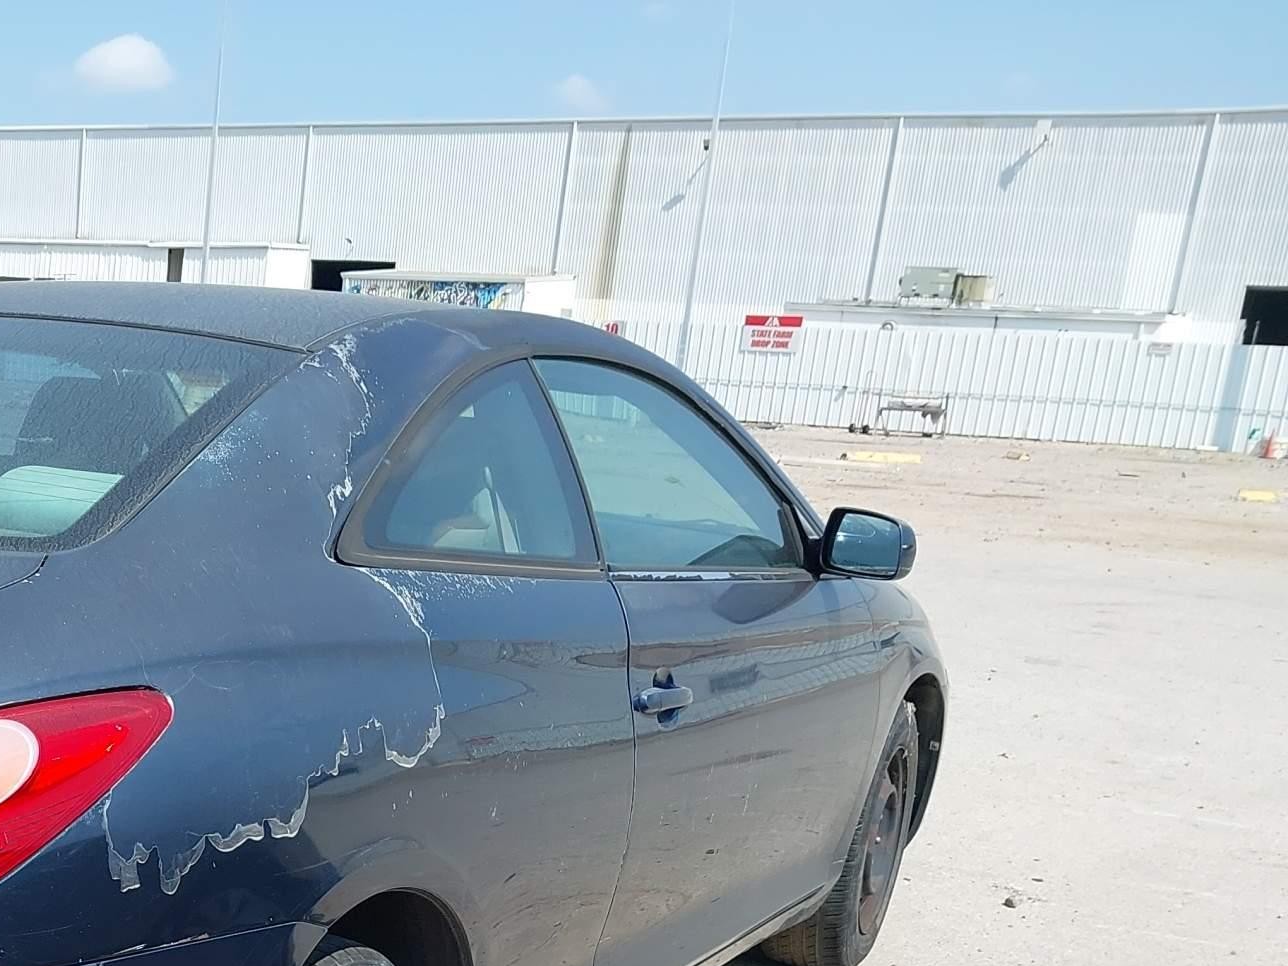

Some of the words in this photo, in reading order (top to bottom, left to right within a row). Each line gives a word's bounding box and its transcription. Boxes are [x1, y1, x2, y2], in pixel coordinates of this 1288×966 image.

[751, 329, 772, 338] STATE
[772, 330, 793, 339] FARM
[751, 339, 771, 348] DROP
[771, 340, 789, 349] ZONE
